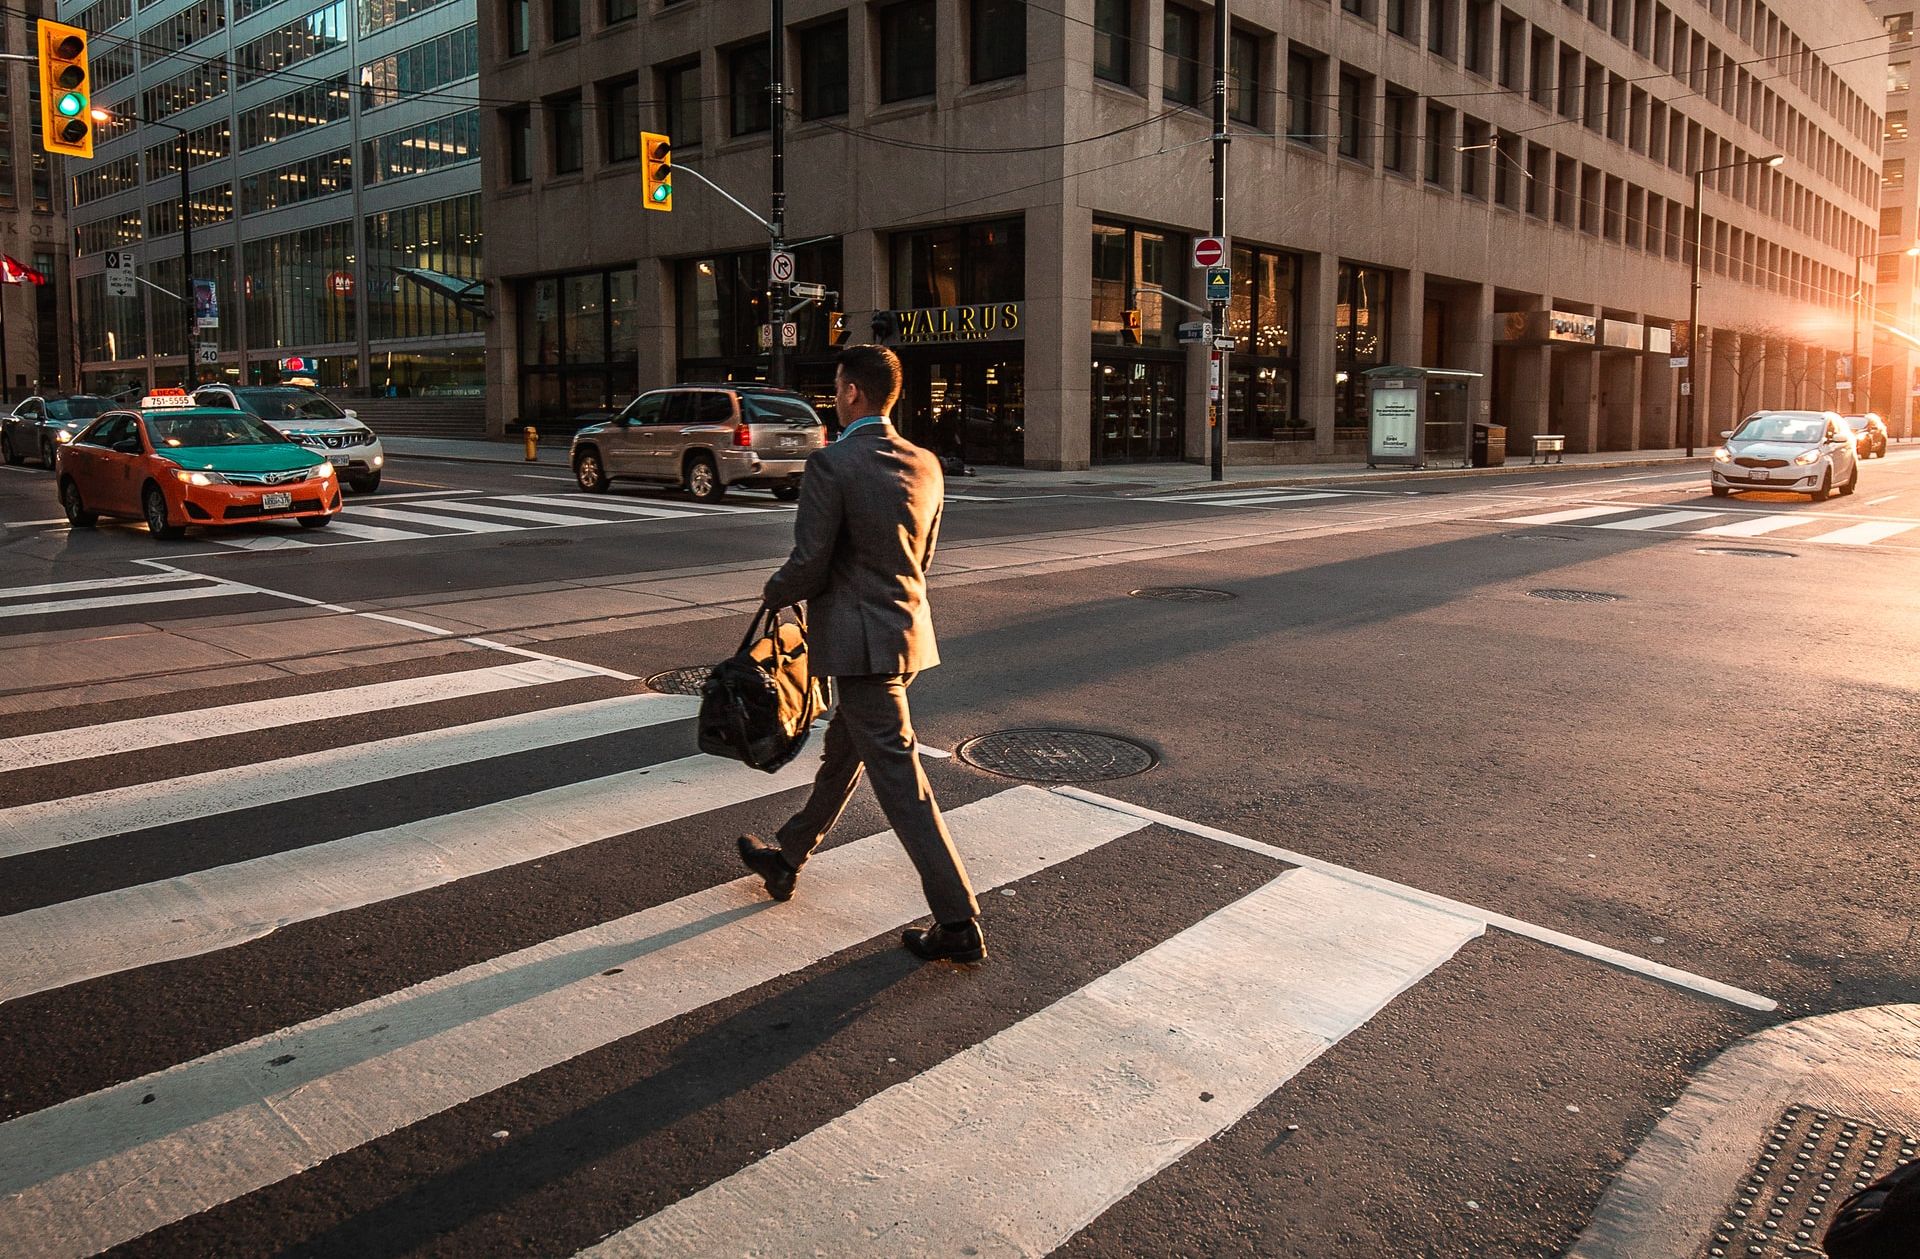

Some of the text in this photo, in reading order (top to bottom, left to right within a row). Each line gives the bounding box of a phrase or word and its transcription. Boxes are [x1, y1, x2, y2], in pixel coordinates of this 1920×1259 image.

[29, 224, 54, 237] OF
[897, 304, 1018, 335] WALRUS
[1187, 330, 1199, 338] Bay
[202, 351, 217, 361] 40
[151, 396, 190, 406] 751-5555
